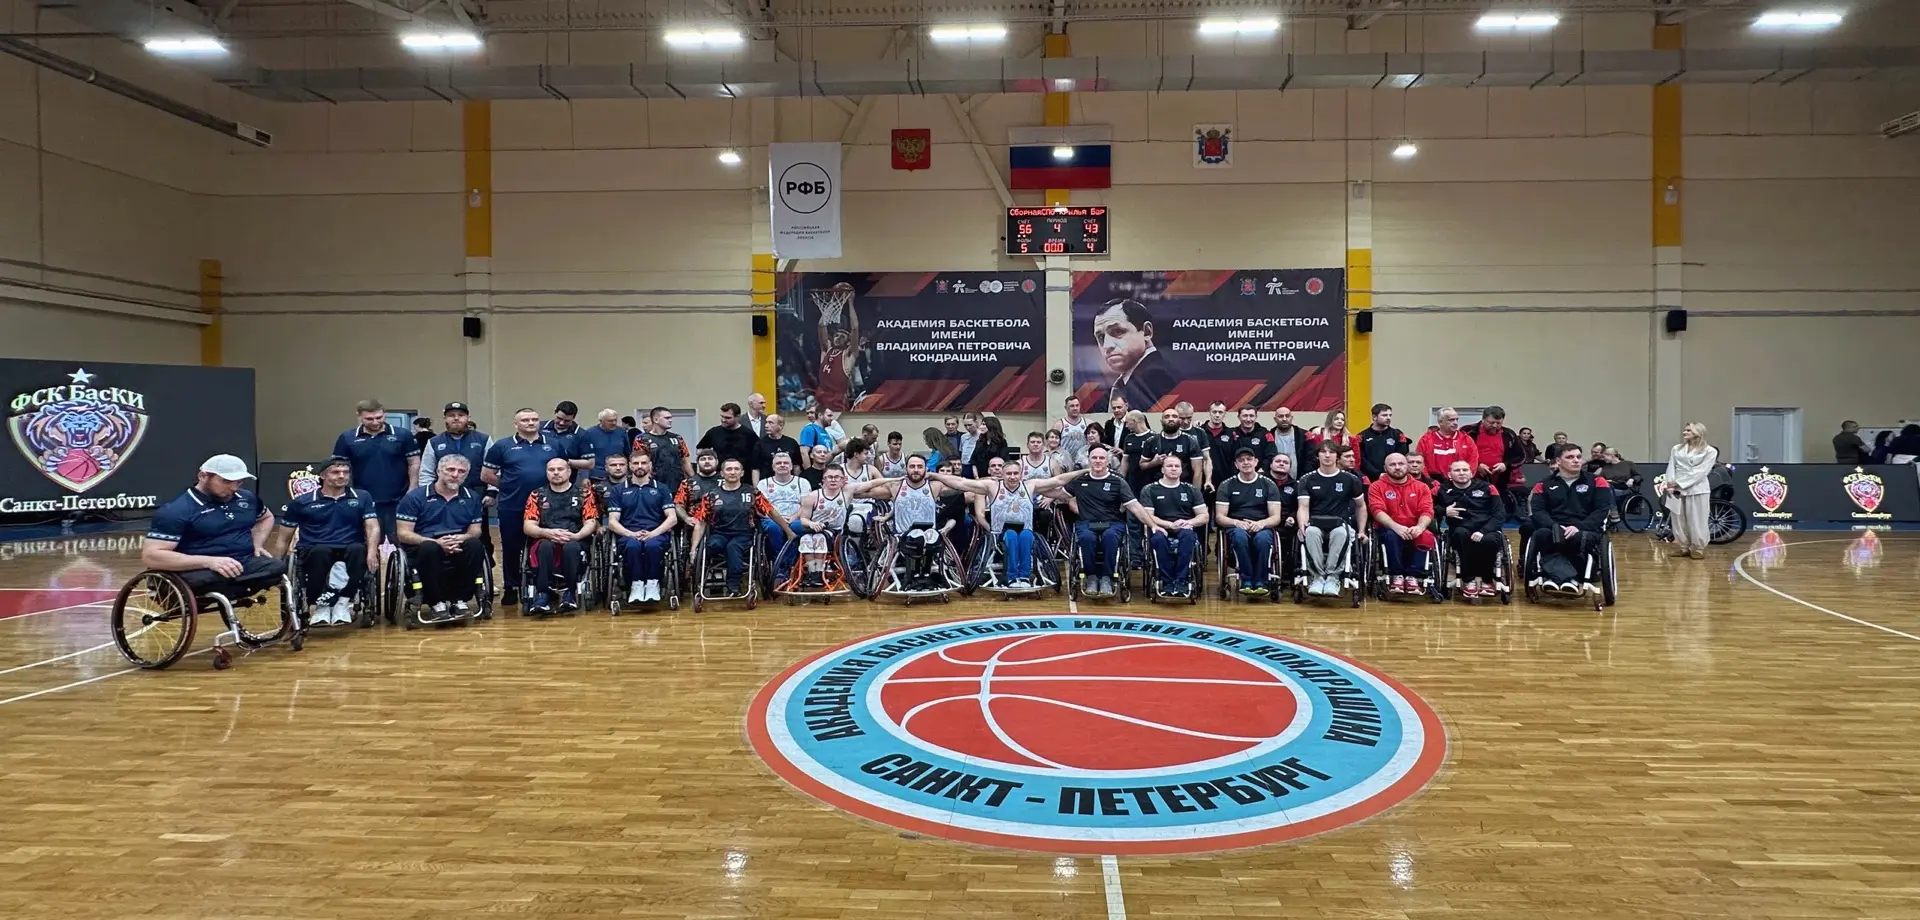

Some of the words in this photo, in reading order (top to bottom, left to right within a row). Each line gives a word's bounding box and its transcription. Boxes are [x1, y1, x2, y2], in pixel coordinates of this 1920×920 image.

[786, 181, 825, 195] РФБ
[1019, 224, 1032, 234] 56
[1053, 223, 1061, 233] 4
[1085, 223, 1099, 234] 43
[1020, 243, 1028, 253] 5
[1086, 243, 1094, 252] 4
[876, 319, 946, 329] АКАДЕМИЯ
[949, 318, 1030, 328] БАСКЕТБОЛА
[1172, 318, 1243, 328] АКАДЕМИЯ
[1246, 317, 1329, 327] БАСКЕТБОЛА
[931, 330, 976, 339] ИМЕНИ
[1228, 330, 1273, 338] ИМЕНИ
[876, 342, 954, 352] ВЛАДИМИРА
[957, 341, 1031, 350] ПЕТРОВИЧА
[1172, 341, 1252, 351] ВЛАДИМИРА
[1255, 340, 1330, 350] ПЕТРОВИЧА
[909, 353, 997, 363] КОНДРАШИНА
[1206, 352, 1296, 363] КОНДРАШИНА
[10, 385, 67, 411] ФСК
[0, 493, 156, 513] Санкт-Петербург
[571, 496, 578, 507] 5
[741, 492, 751, 503] 16
[804, 658, 879, 742] АКАДЕМИЯ
[863, 620, 1059, 659] БАСКЕТБОЛА
[1074, 620, 1189, 636] ИМЕНИ
[1187, 628, 1248, 649] В.П.
[1246, 644, 1382, 747] КОНДРАШИНА
[860, 753, 1024, 808] САНКТ
[1058, 757, 1332, 815] ПЕТЕРБУРГ
